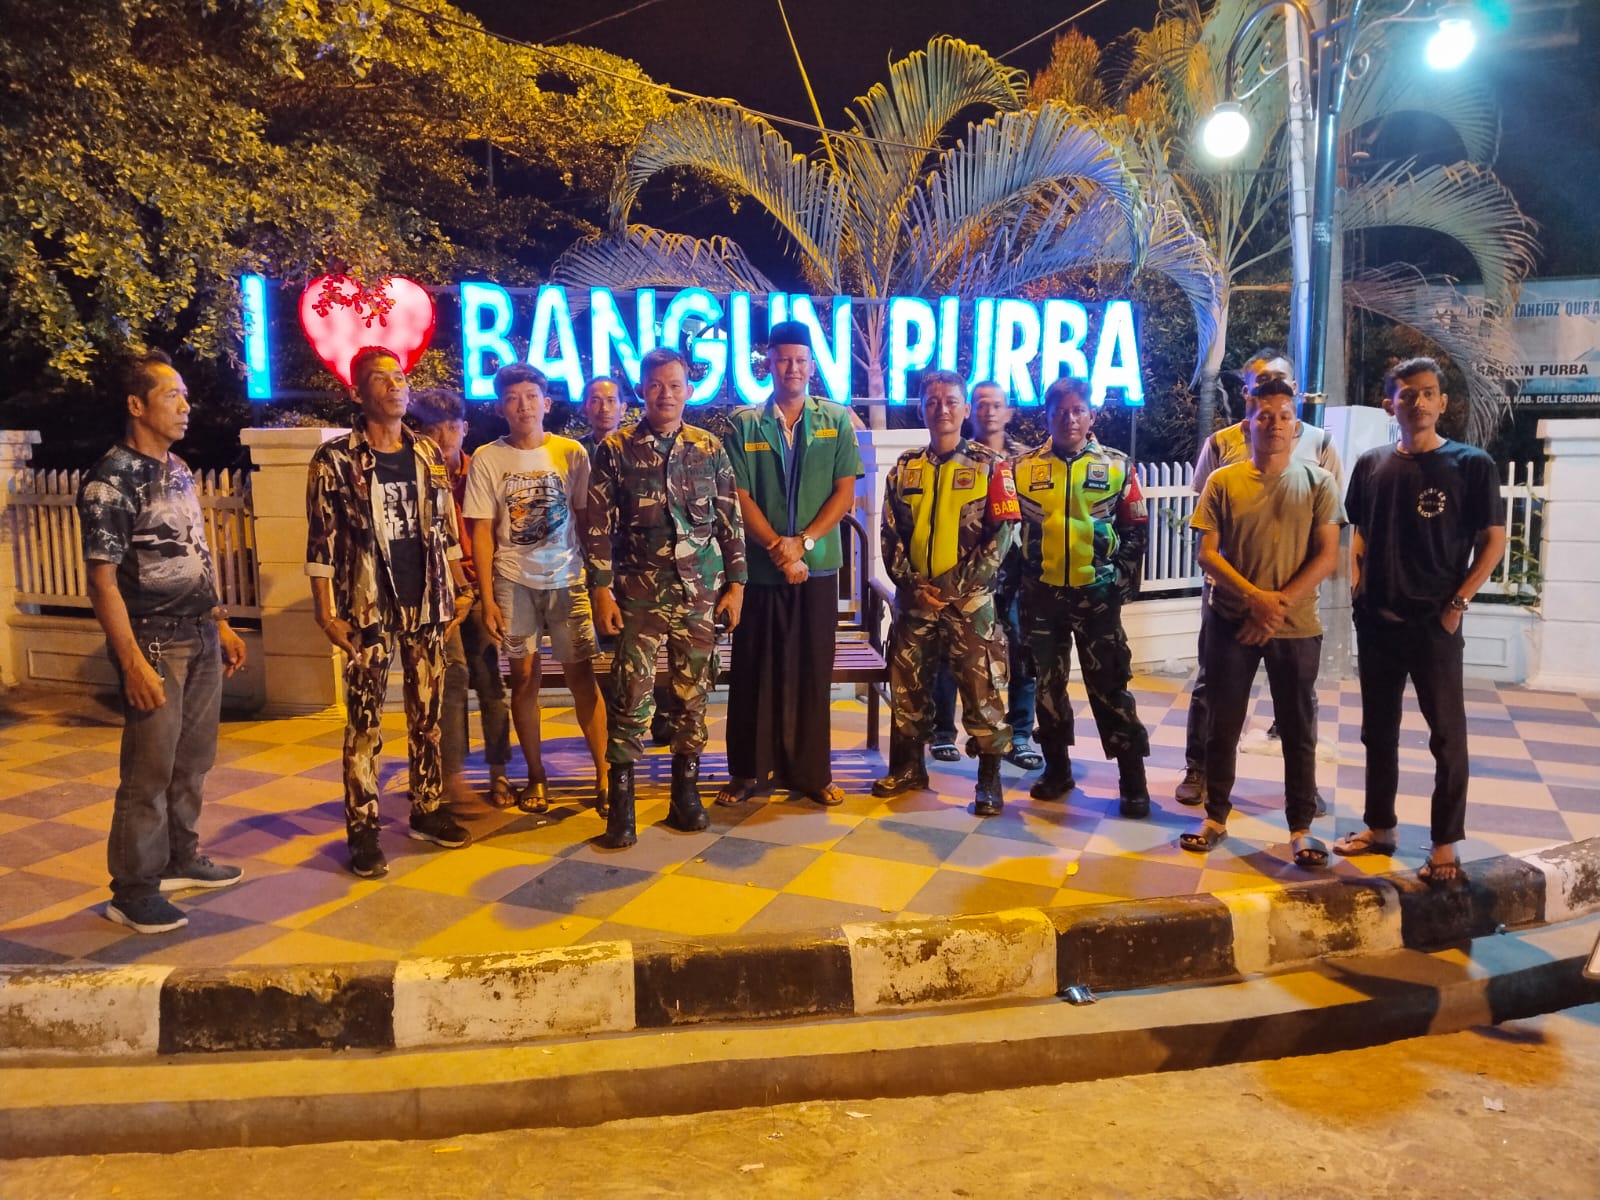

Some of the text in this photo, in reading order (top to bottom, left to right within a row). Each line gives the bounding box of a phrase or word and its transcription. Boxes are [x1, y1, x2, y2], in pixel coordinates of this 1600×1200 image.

[1514, 302, 1560, 318] TAHFIDZ
[240, 274, 1146, 407] I BANGUN PURBA
[1539, 364, 1589, 376] PURBA
[1537, 395, 1558, 404] DELI
[1560, 394, 1600, 404] SERDAN
